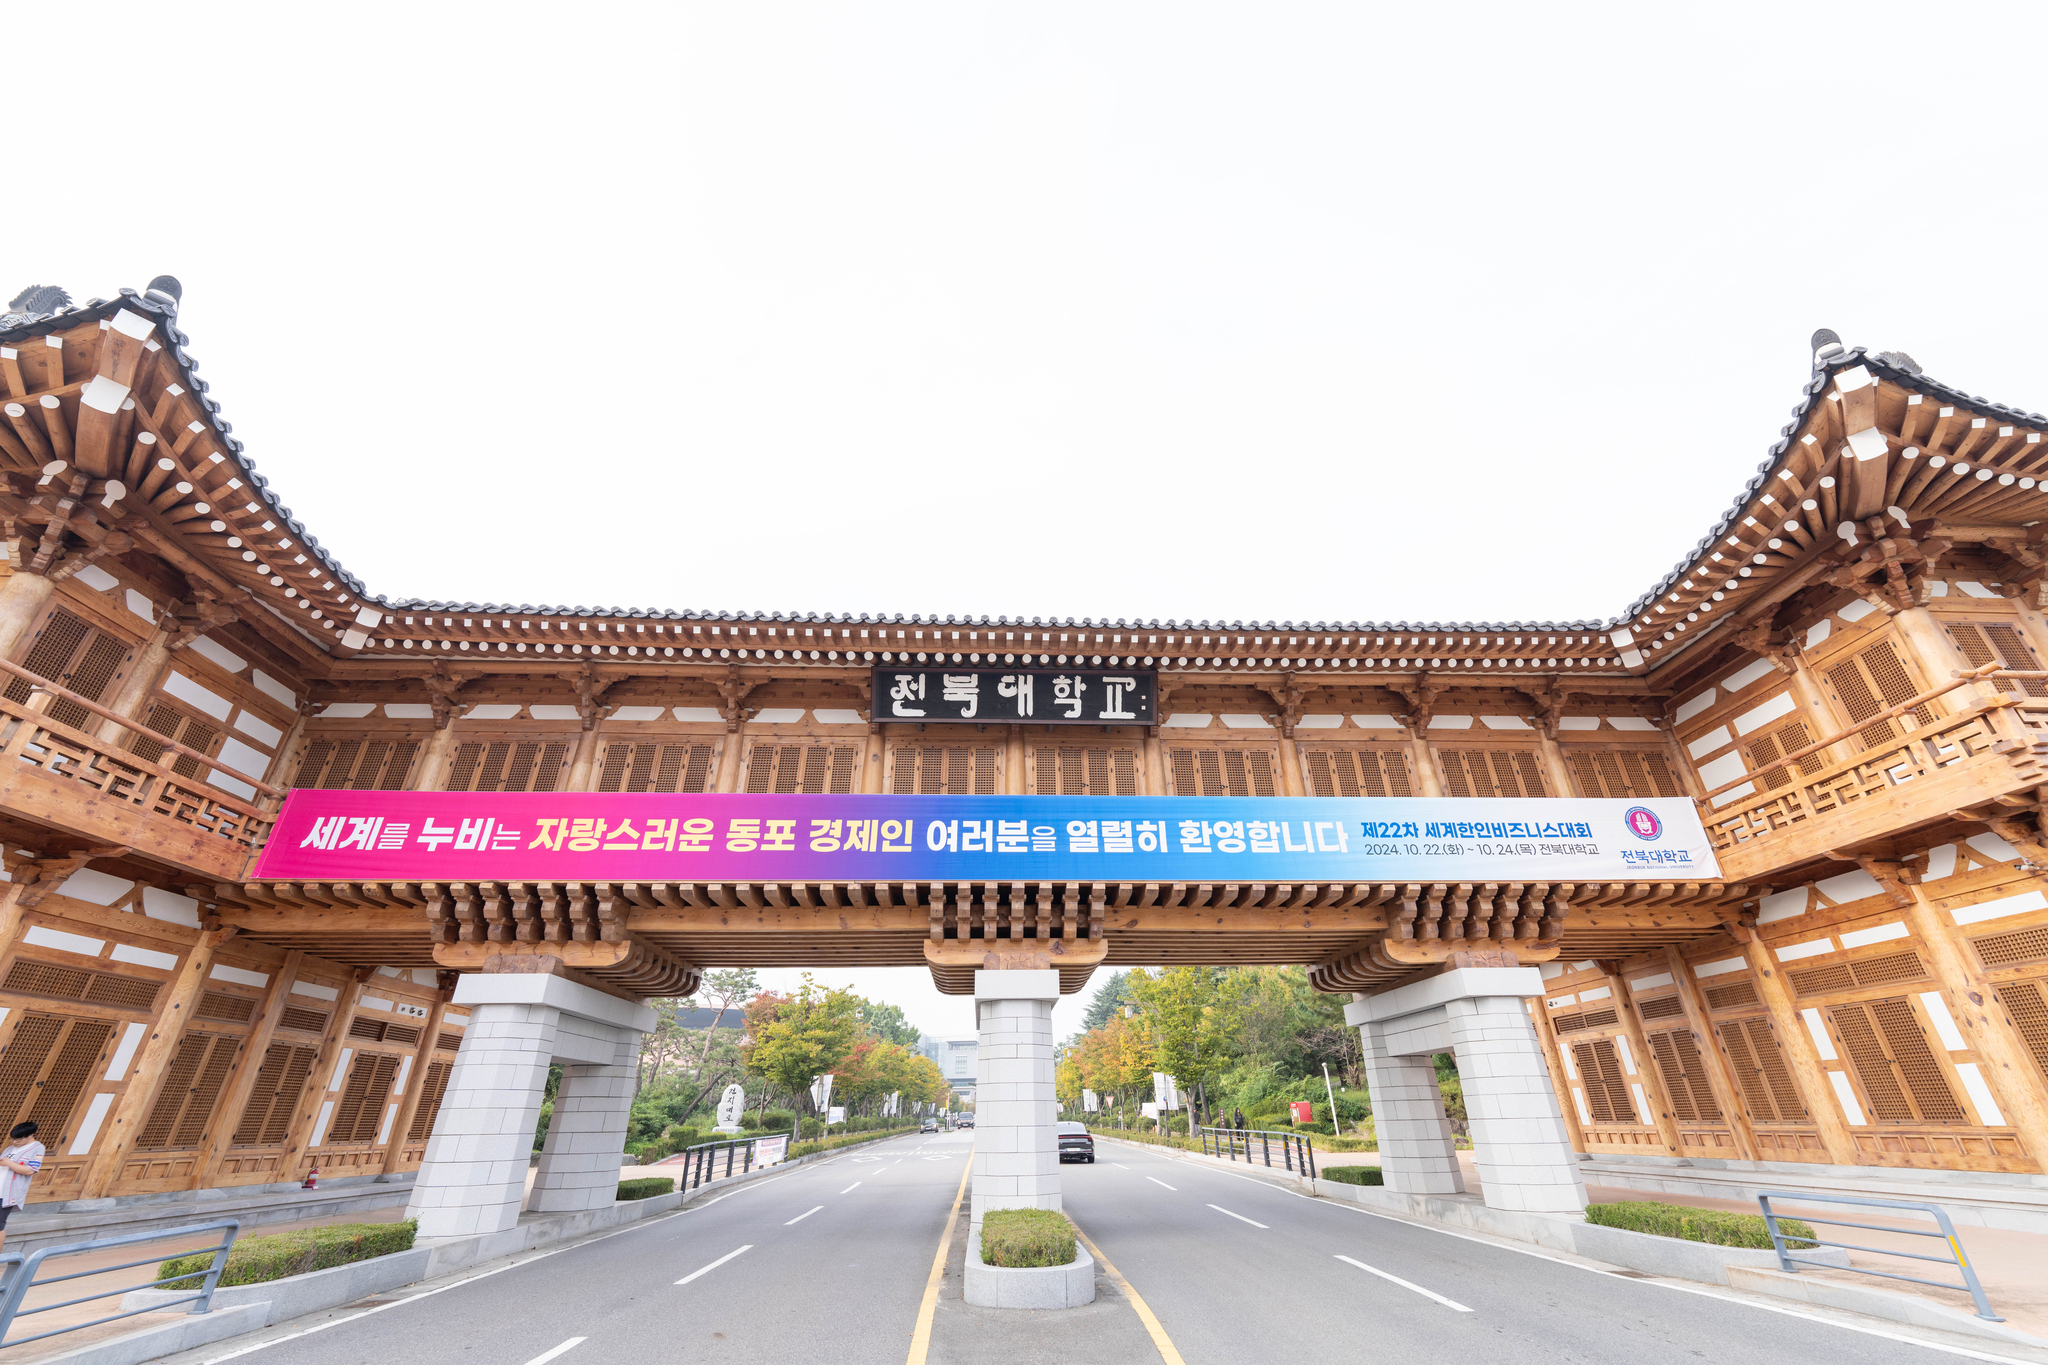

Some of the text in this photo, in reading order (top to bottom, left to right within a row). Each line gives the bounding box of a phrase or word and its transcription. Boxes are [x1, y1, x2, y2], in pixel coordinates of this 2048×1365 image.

[889, 673, 1137, 719] 전북대학교
[300, 817, 1349, 853] 세계를 누비는 자랑스러운 동포 경제인 여러분을 열렬히 환영합니다
[1361, 822, 1593, 838] 제22차 세계한인비즈니스대회
[1364, 844, 1402, 855] 2024.
[1404, 843, 1422, 855] 10.
[1424, 843, 1464, 856] 22.(화)
[1476, 843, 1495, 855] 10.
[1497, 843, 1537, 856] 24.(목)
[1540, 844, 1600, 856] 전북대학교
[1620, 849, 1693, 864] 전북대학교
